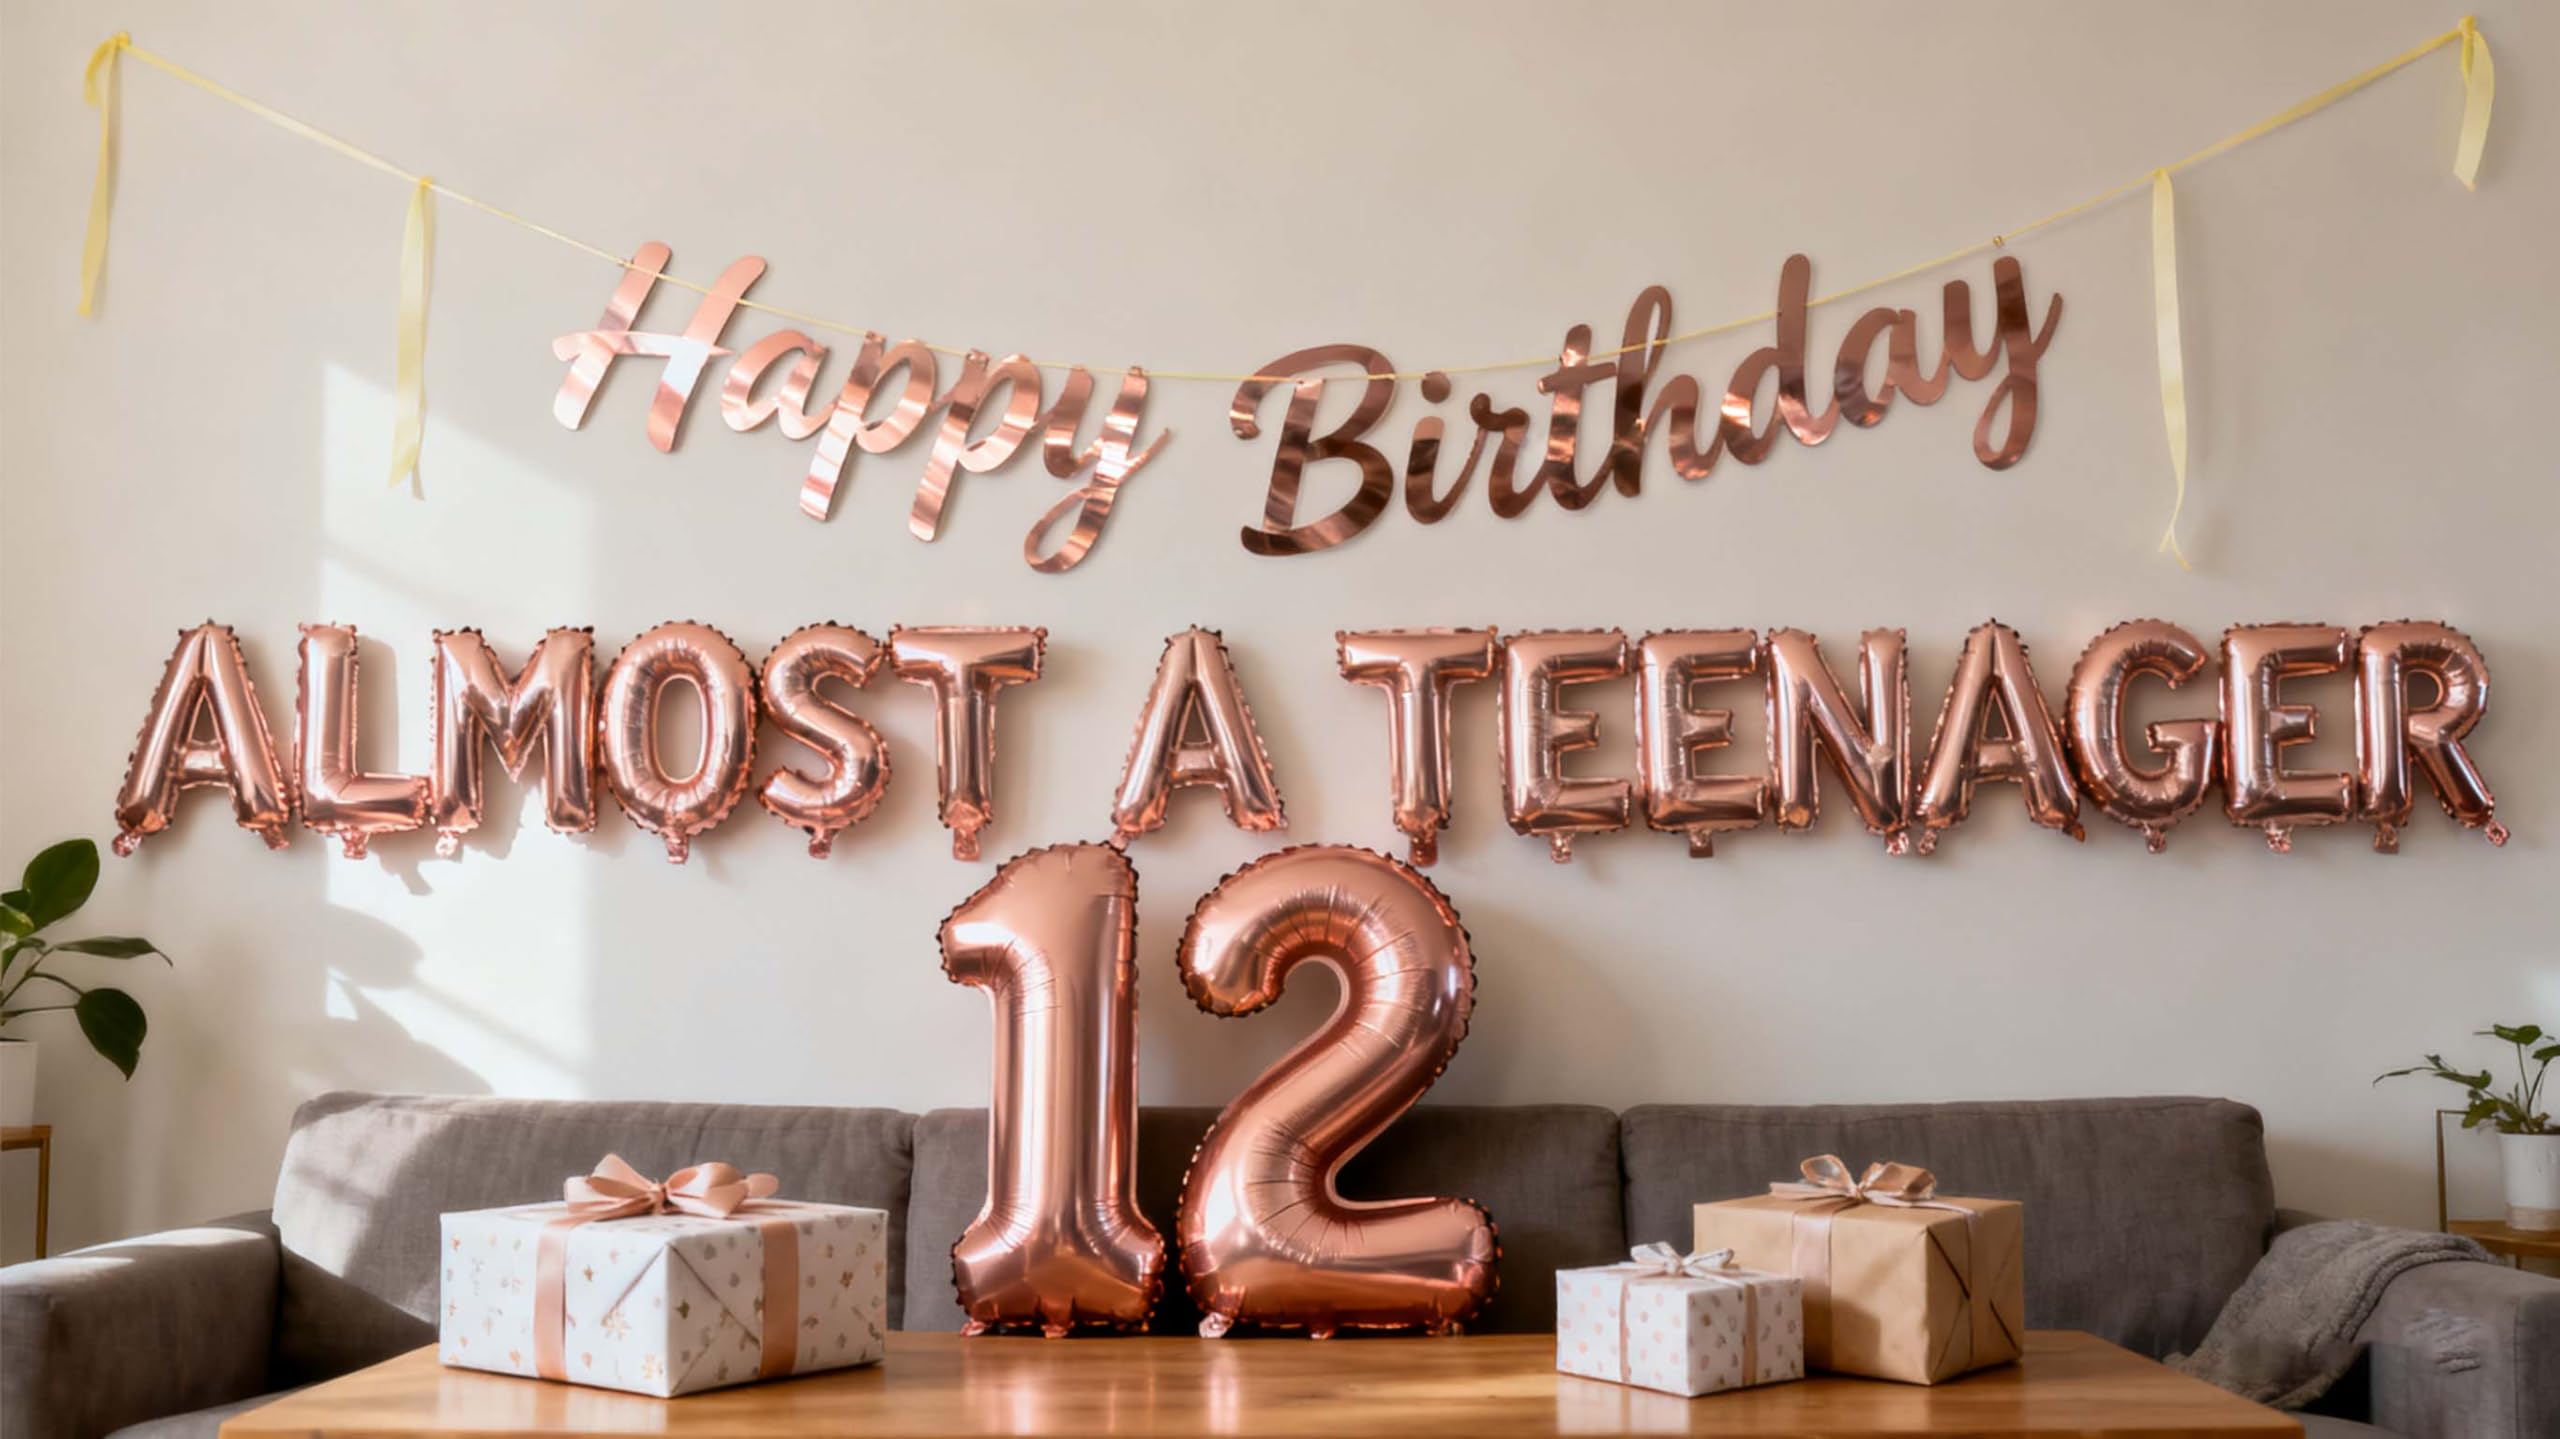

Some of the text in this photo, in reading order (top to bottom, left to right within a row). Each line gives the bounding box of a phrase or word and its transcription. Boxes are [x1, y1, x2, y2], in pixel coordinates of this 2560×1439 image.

[552, 241, 2063, 573] Happy Birthday
[113, 618, 2507, 860] ALMOST A TEENAGER
[937, 840, 1503, 1337] 12
